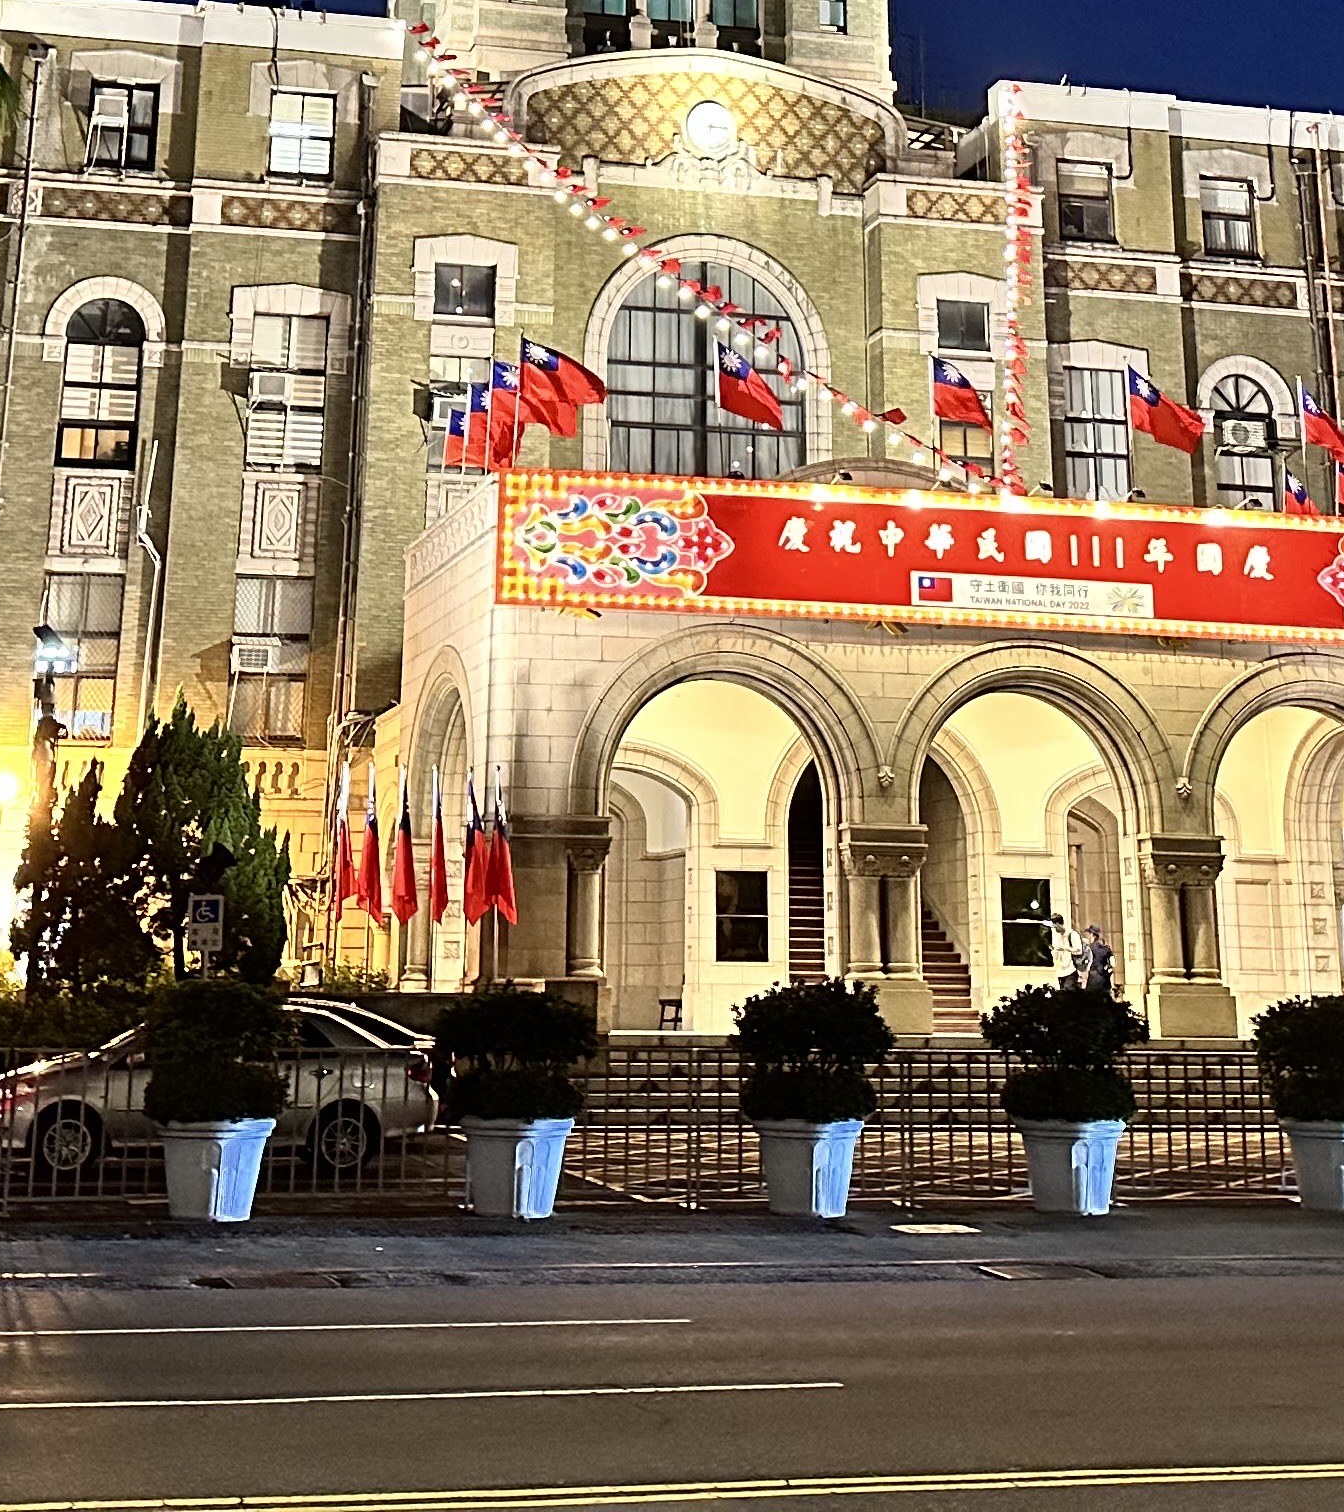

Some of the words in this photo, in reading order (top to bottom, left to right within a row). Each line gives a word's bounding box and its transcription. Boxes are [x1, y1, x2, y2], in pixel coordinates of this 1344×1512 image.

[1035, 582, 1089, 599] 你我同行
[969, 595, 1003, 605] TAIWAN
[1005, 598, 1048, 608] NATIONAL
[1049, 600, 1067, 609] DAY
[1068, 601, 1090, 610] 2022
